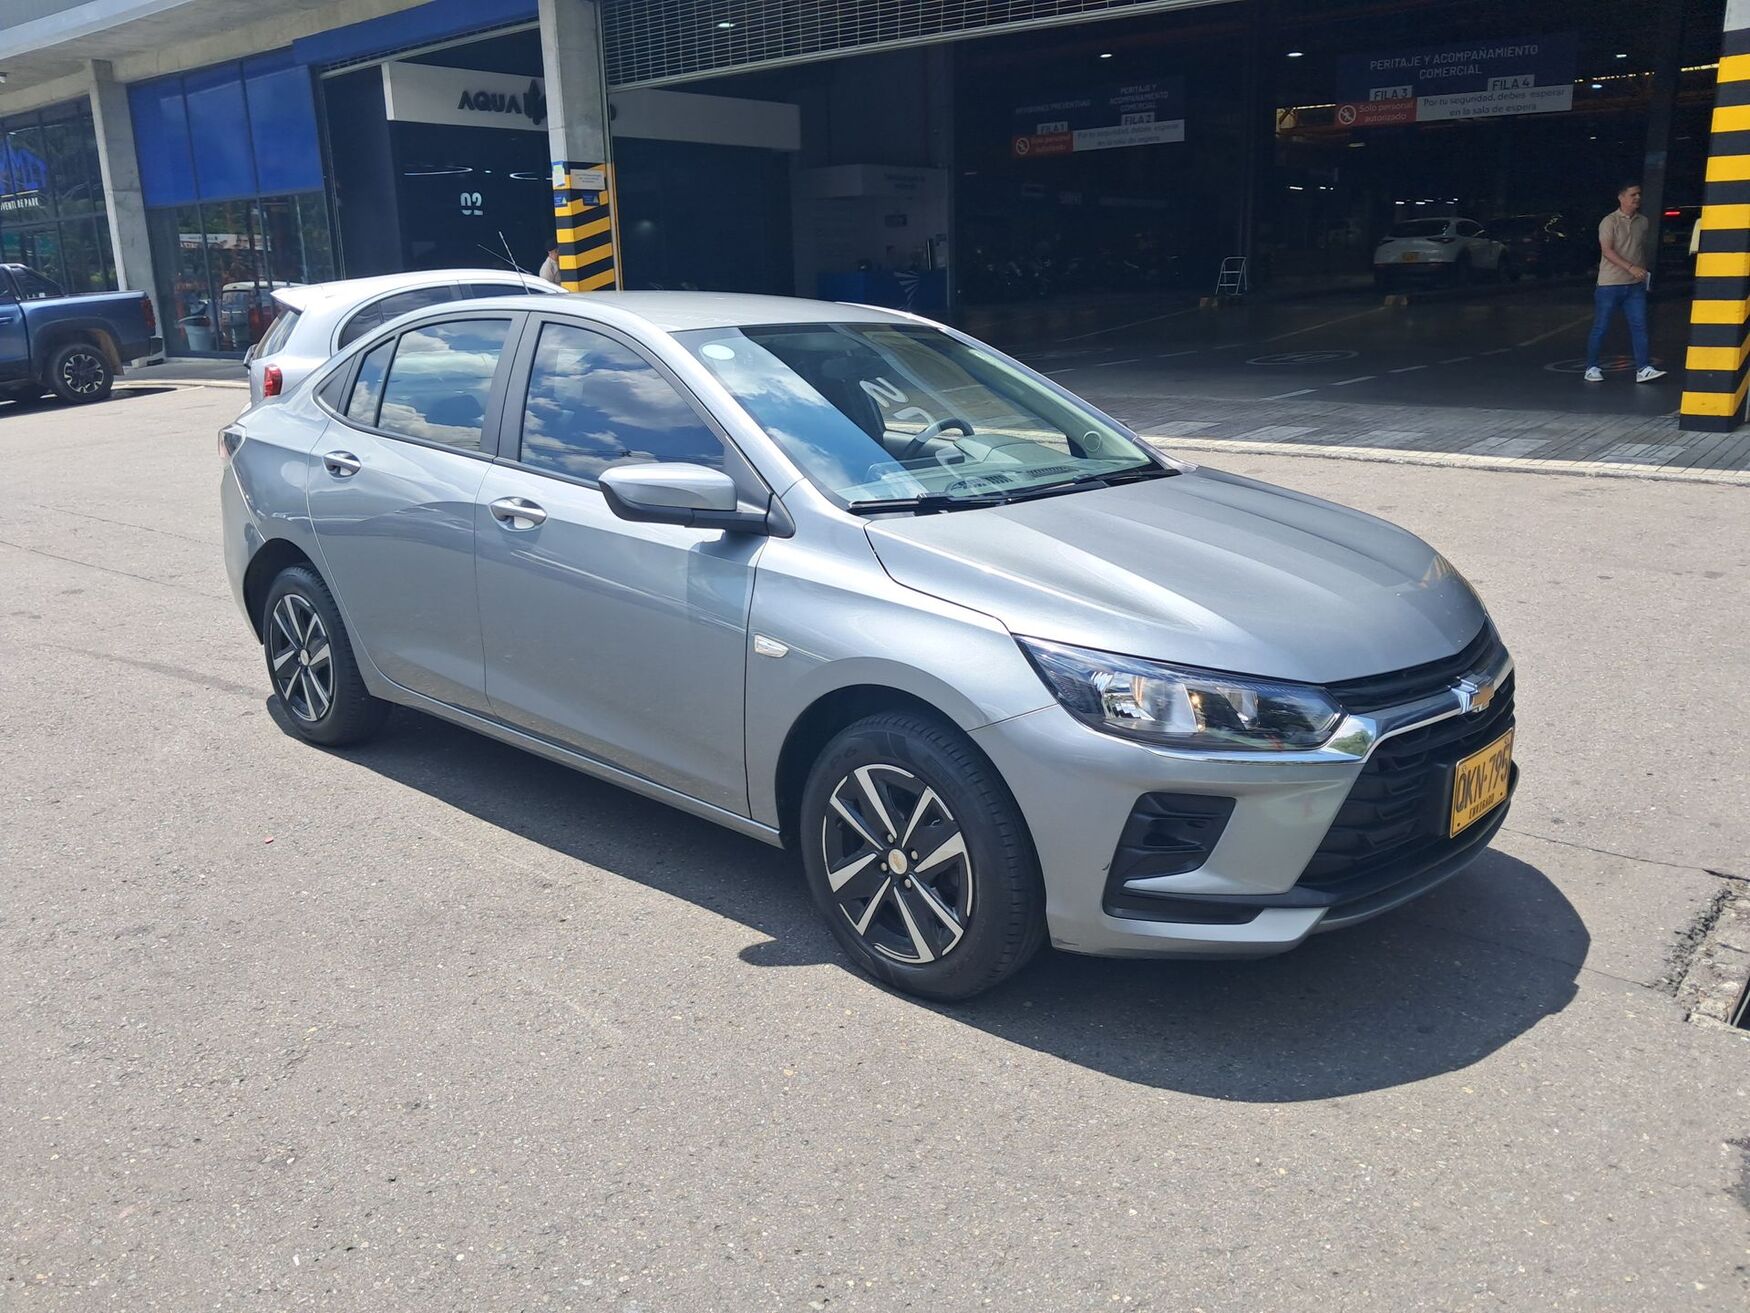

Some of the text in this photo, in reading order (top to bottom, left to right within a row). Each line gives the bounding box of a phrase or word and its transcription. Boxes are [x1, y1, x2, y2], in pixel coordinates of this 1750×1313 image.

[1370, 45, 1540, 71] PERITAJE Y ACOMPAÑAMIENTO
[1420, 65, 1483, 80] COMERCIAL
[1493, 77, 1531, 92] FILA 4
[457, 90, 523, 114] AQUA
[1375, 88, 1409, 101] FILA 3
[460, 192, 483, 216] 02
